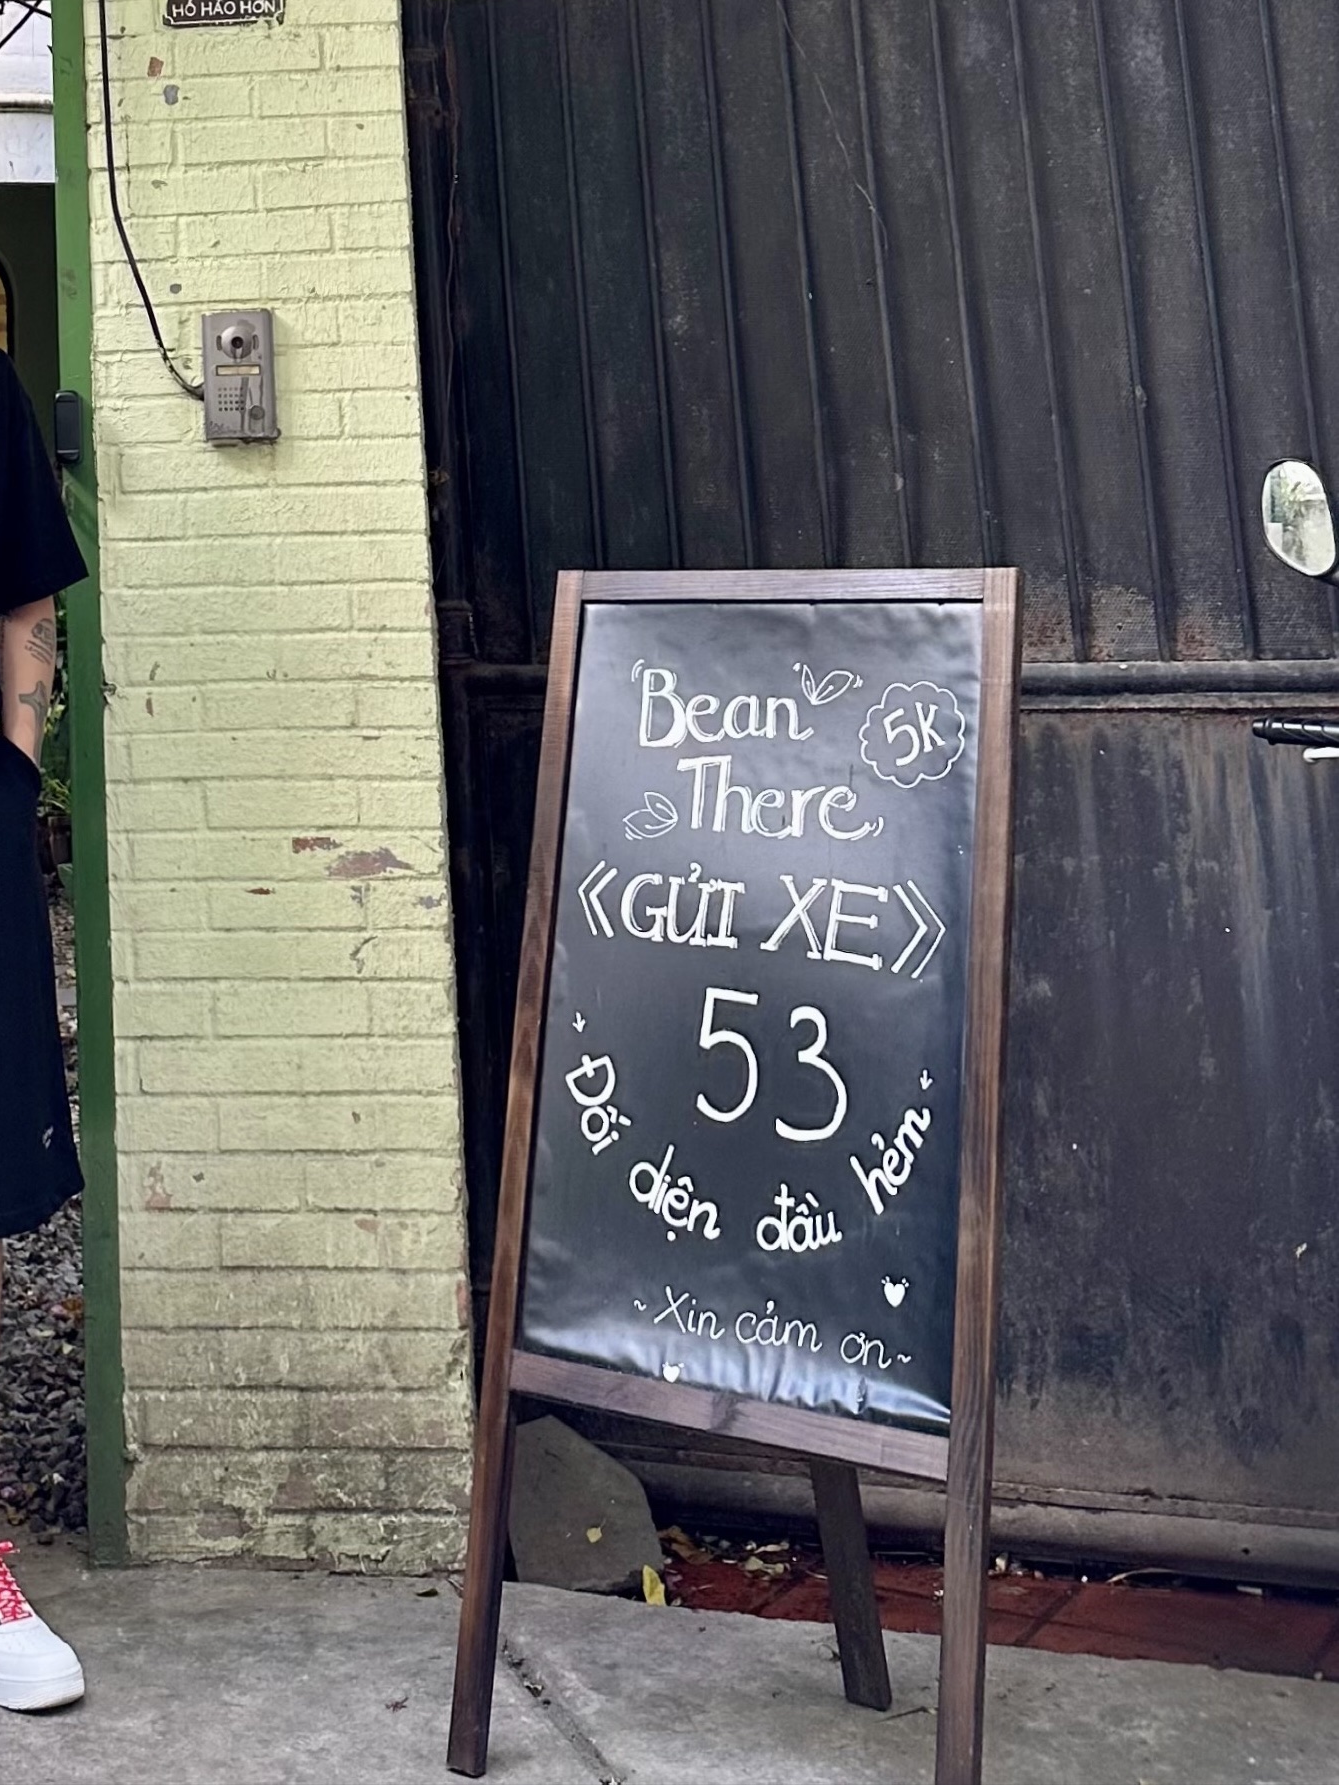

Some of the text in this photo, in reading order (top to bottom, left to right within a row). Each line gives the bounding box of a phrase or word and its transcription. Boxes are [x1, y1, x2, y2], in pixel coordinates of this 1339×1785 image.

[638, 667, 814, 748] Bean
[882, 701, 947, 767] 5K
[676, 754, 872, 841] There
[696, 987, 849, 1142] 53
[565, 1054, 932, 1253] Đối diện đầu hẻm
[734, 1300, 823, 1353] cảm
